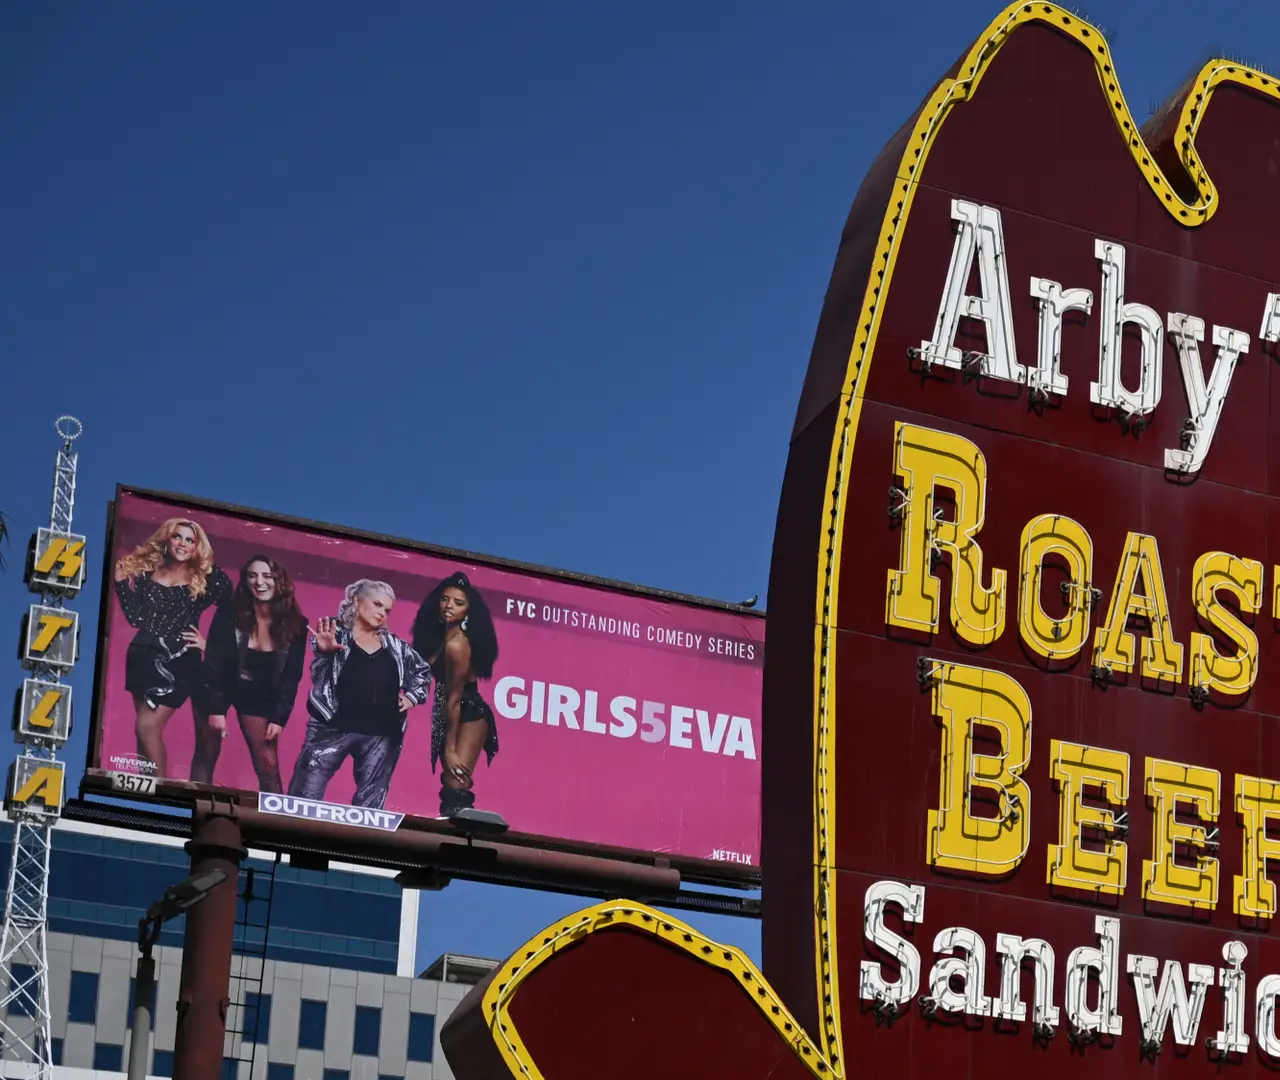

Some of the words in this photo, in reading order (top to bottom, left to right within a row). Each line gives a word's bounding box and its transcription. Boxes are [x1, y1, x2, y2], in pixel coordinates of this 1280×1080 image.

[506, 599, 536, 618] FYC
[542, 606, 640, 639] OUTSTANDING
[647, 625, 702, 650] COMEDY
[708, 637, 755, 659] SERIES
[493, 675, 757, 760] GIRLS5EVA
[110, 756, 158, 769] UNIVERSAL
[117, 774, 153, 792] 3577
[264, 795, 396, 829] OUTFRONT
[713, 849, 752, 865] NETFLIX
